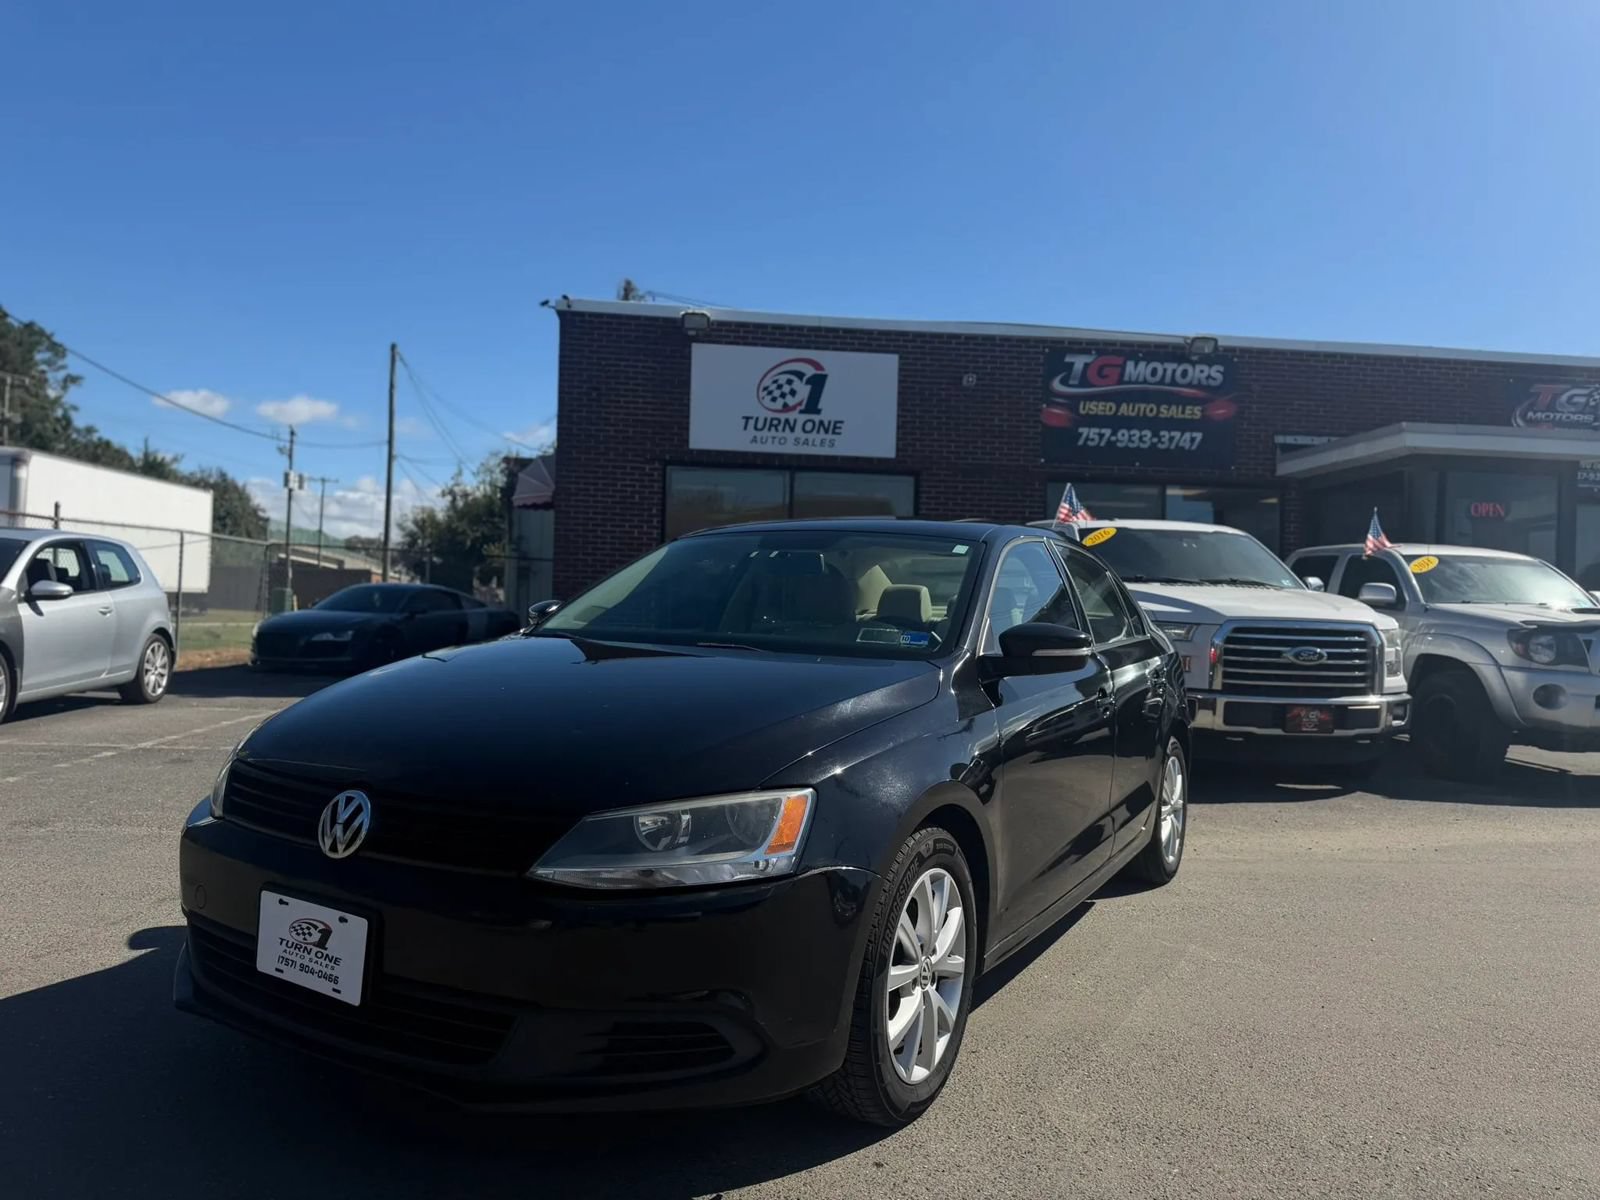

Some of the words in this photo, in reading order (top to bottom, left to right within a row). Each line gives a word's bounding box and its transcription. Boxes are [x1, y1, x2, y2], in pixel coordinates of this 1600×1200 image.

[1064, 354, 1125, 386] TG
[1123, 361, 1225, 386] MOTORS
[1078, 401, 1116, 416] USED
[1117, 403, 1157, 418] AUTO
[1159, 405, 1203, 420] SALES
[1526, 411, 1596, 423] MOTORS
[741, 415, 798, 434] TURN
[801, 418, 845, 436] ONE
[750, 435, 788, 446] AUTO
[793, 437, 836, 448] SALES
[1077, 427, 1203, 451] 757-933-3747
[1470, 502, 1505, 517] OPEN
[1086, 529, 1111, 545] 2016
[279, 937, 313, 955] TURN
[314, 950, 342, 966] ONE
[283, 949, 305, 960] AUTO
[308, 957, 336, 971] SALES
[299, 963, 340, 985] 904-0466
